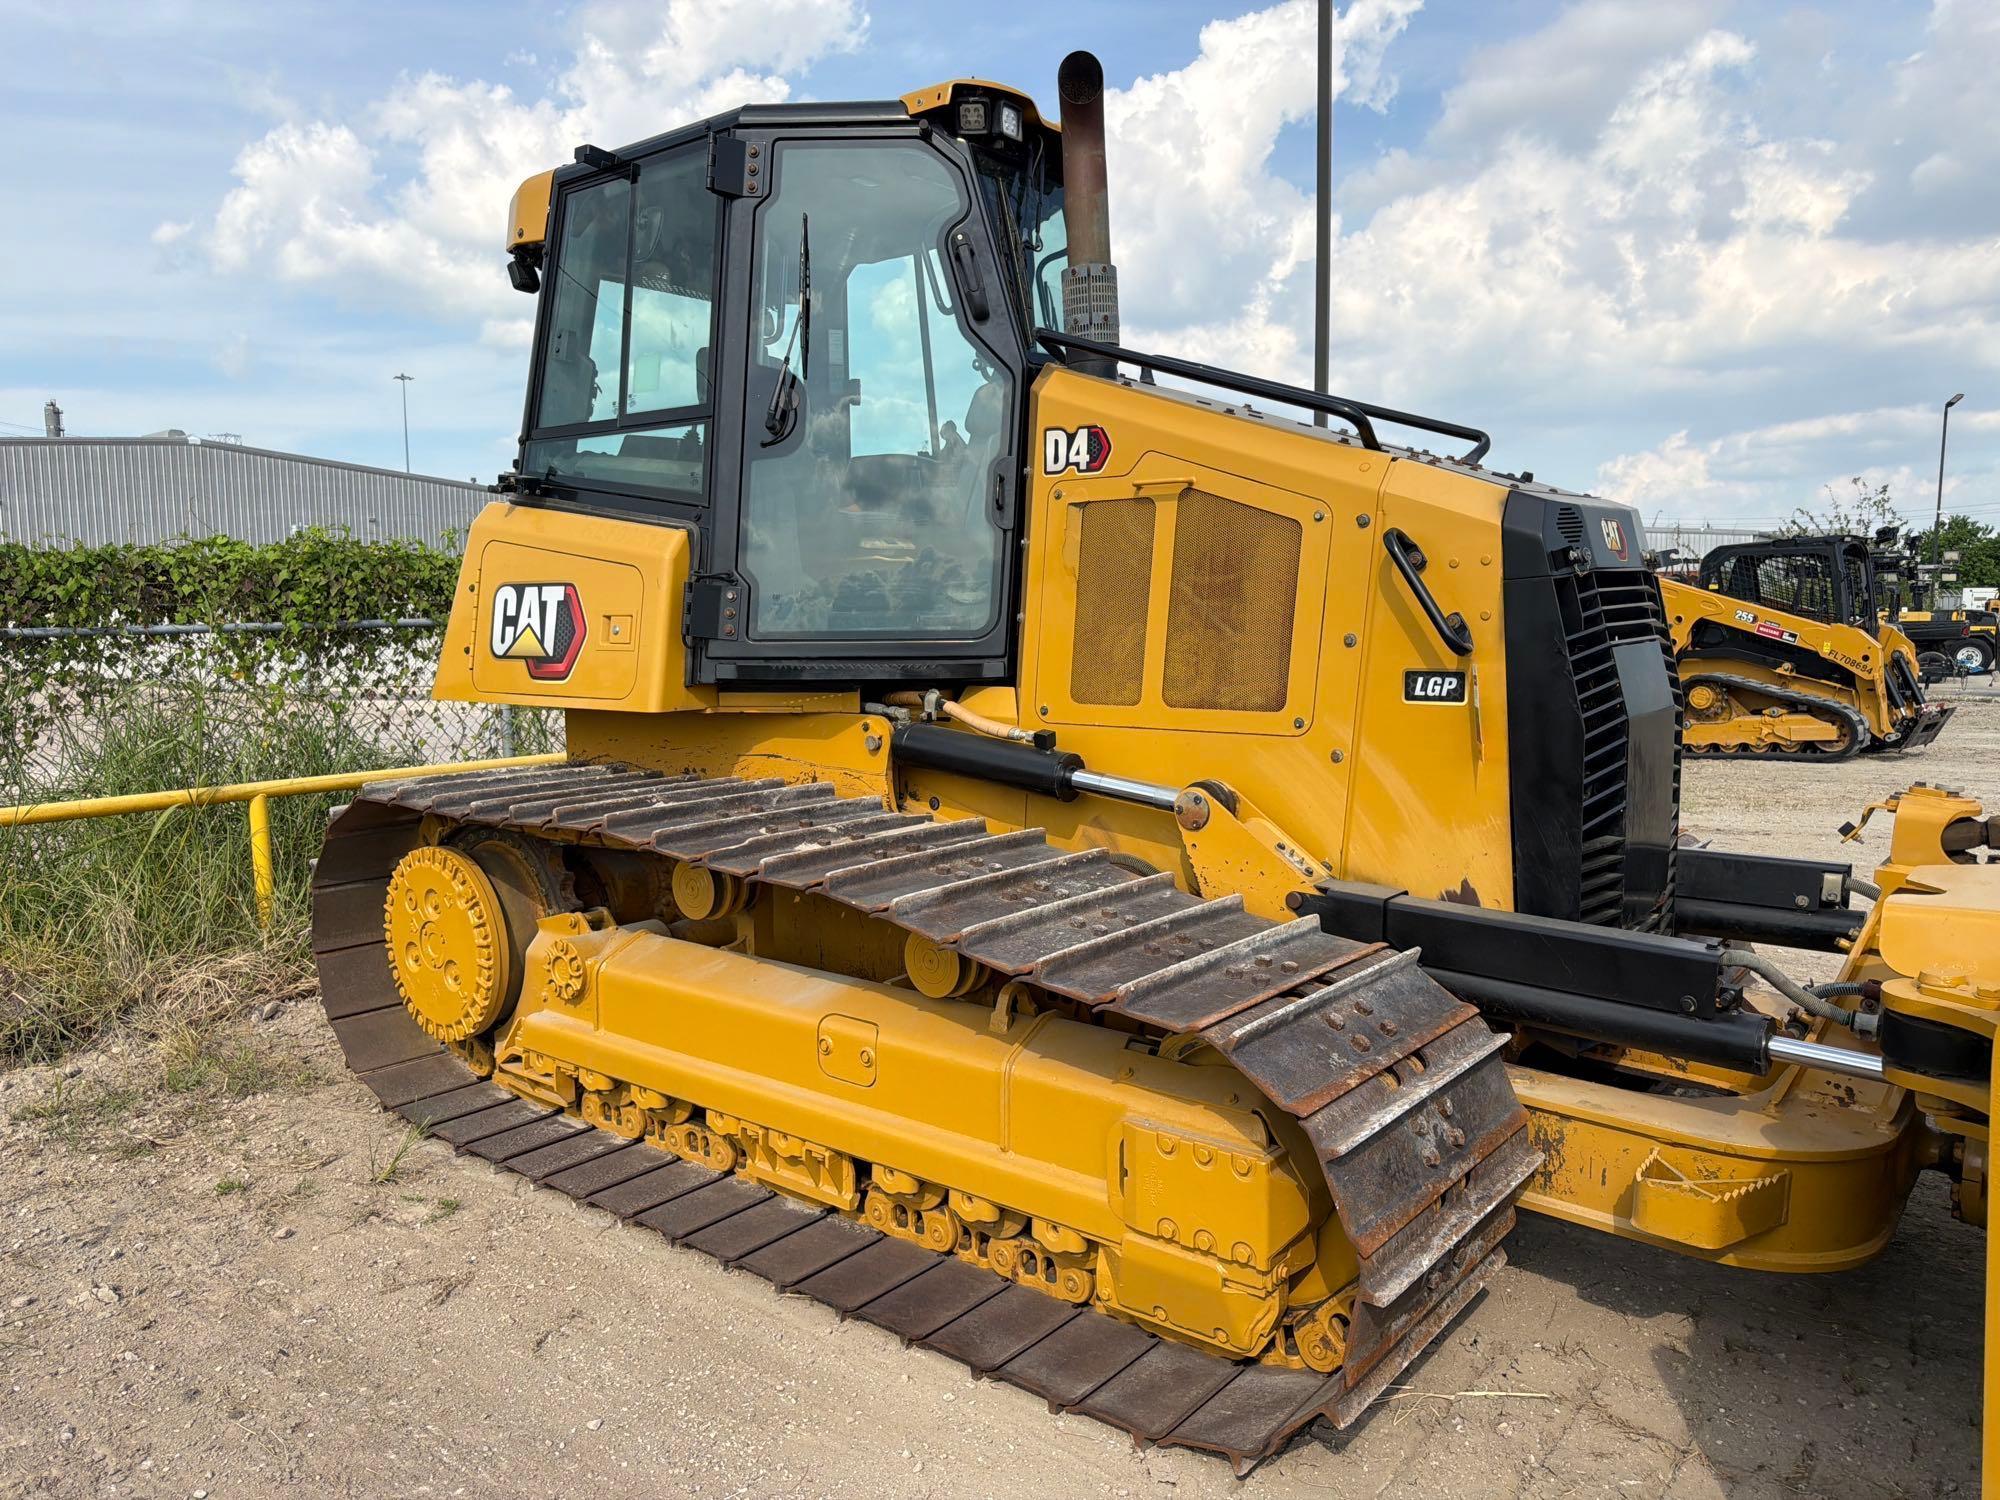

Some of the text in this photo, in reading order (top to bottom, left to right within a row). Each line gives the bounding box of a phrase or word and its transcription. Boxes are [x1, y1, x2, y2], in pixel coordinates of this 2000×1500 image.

[1045, 428, 1090, 472] D4
[1601, 519, 1622, 550] CAT
[492, 585, 565, 656] CAT
[1735, 610, 1754, 623] 255
[1414, 676, 1458, 697] LGP
